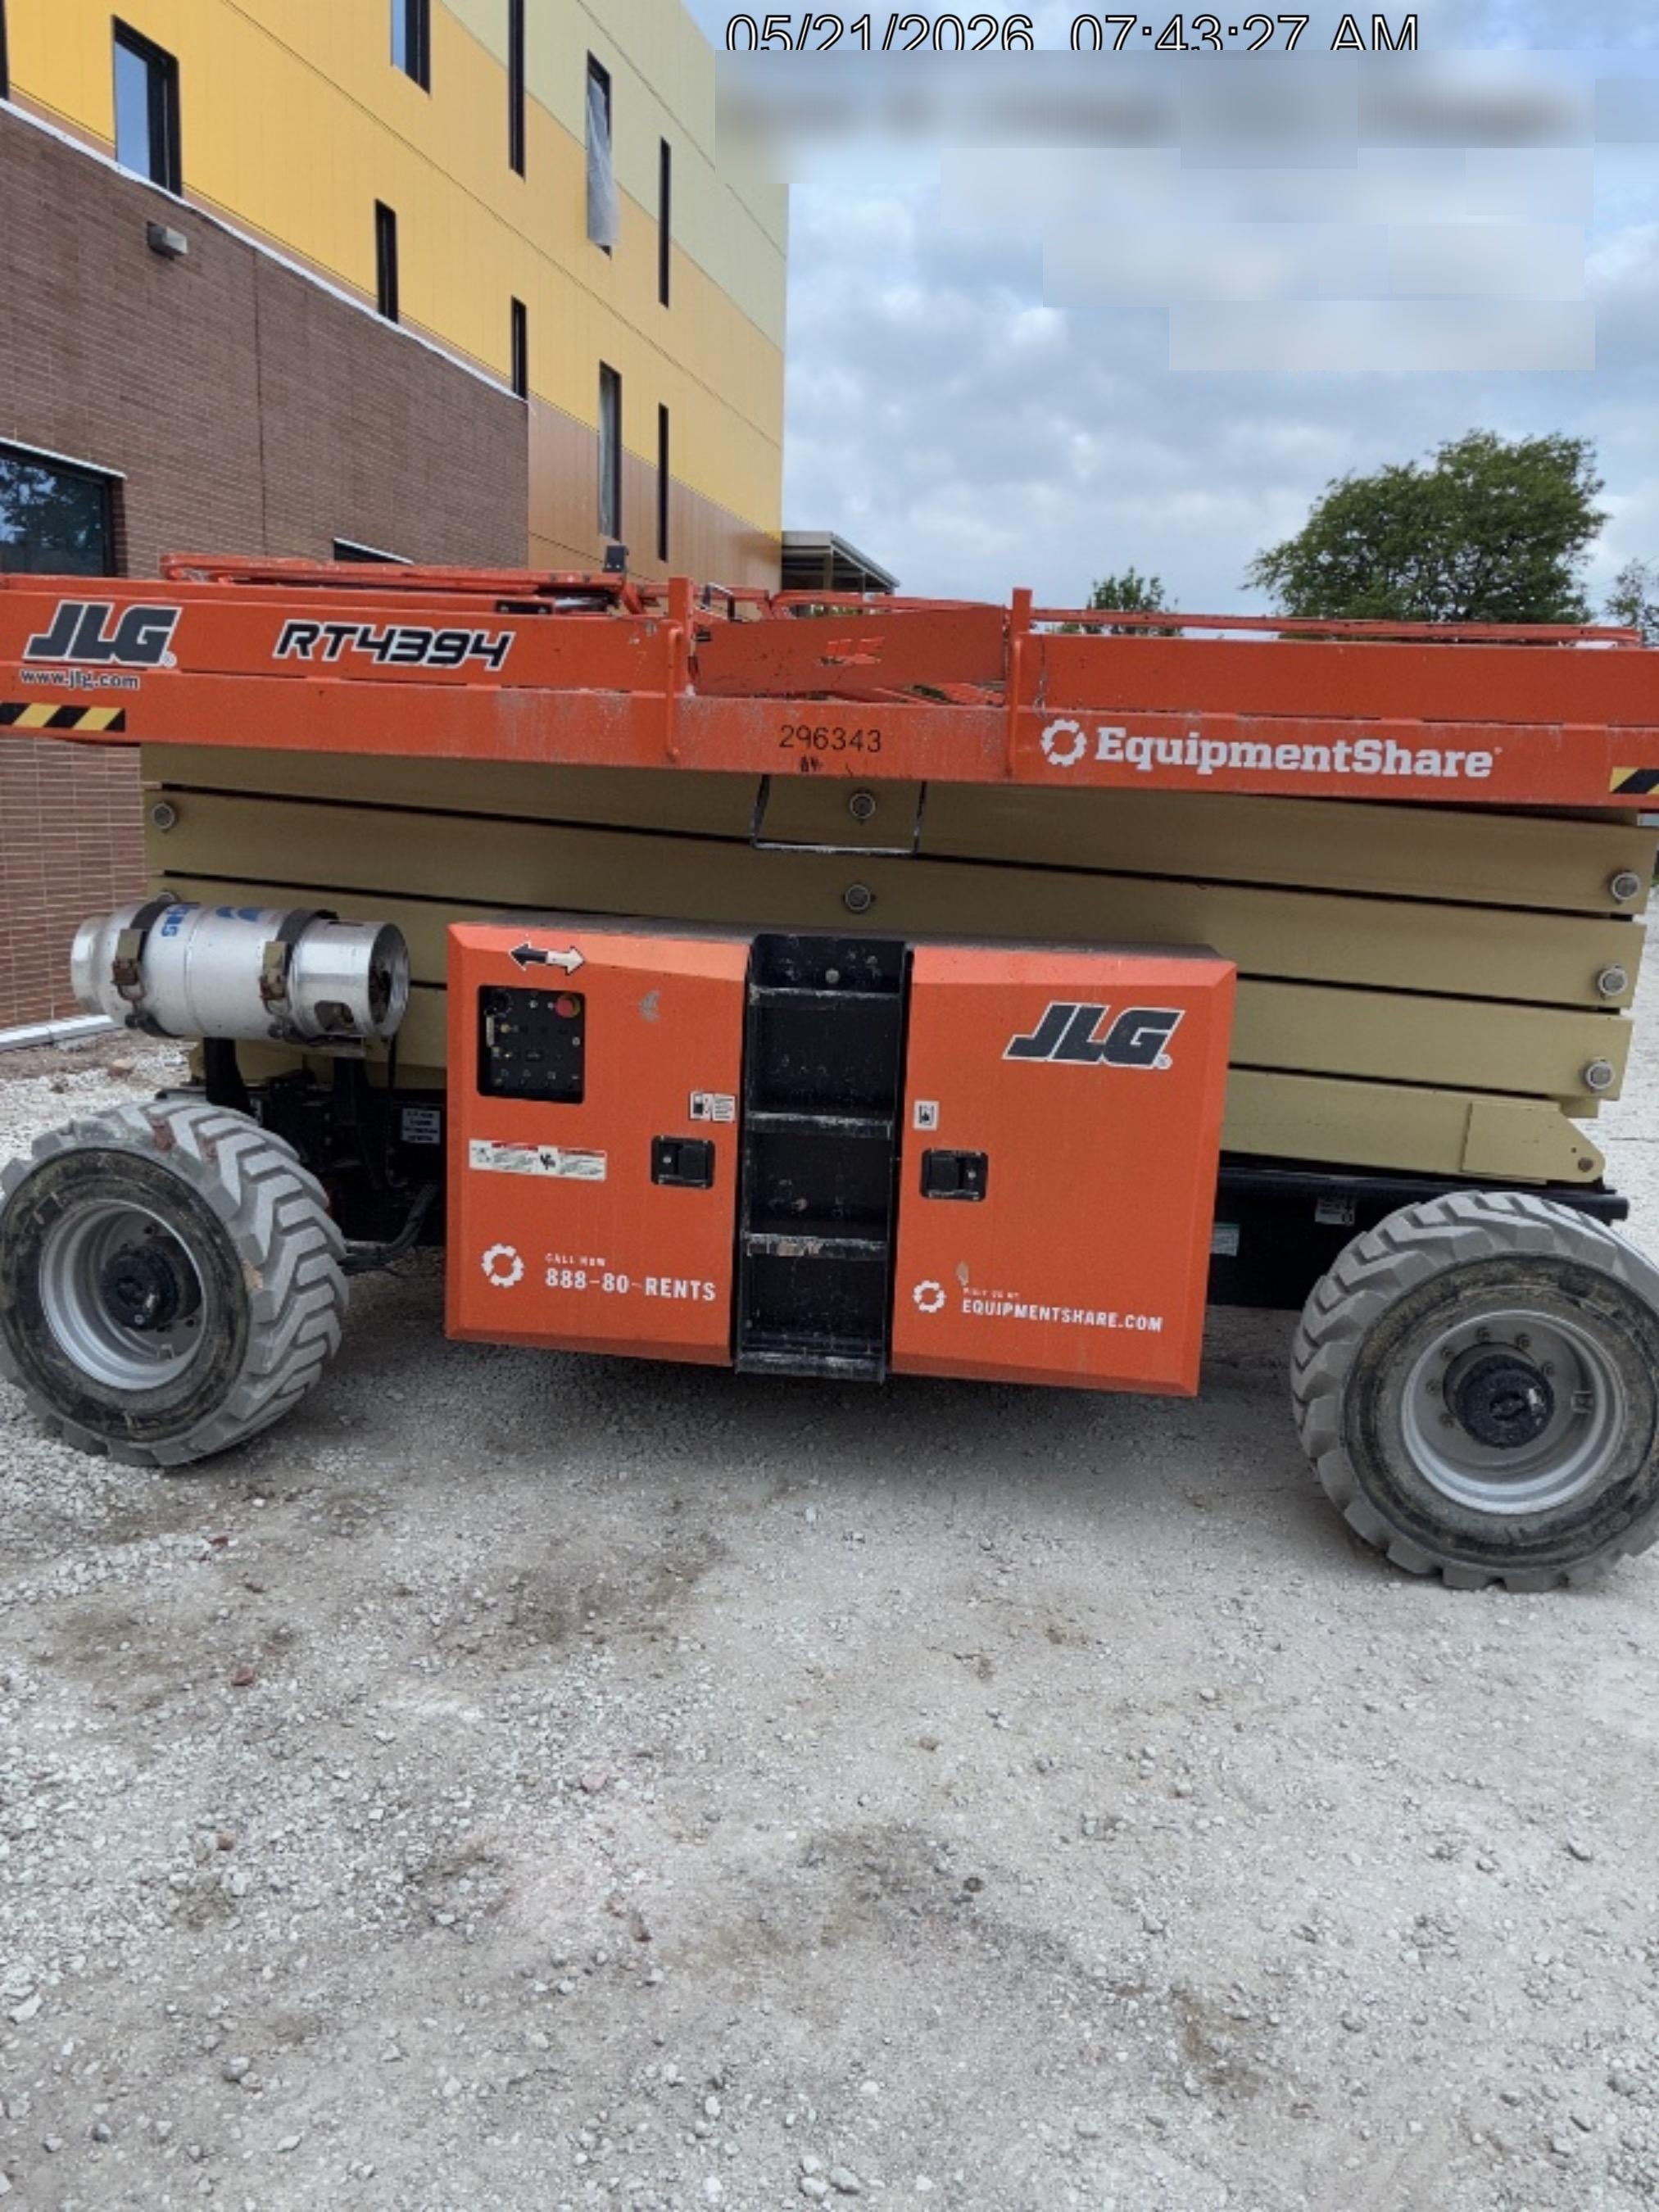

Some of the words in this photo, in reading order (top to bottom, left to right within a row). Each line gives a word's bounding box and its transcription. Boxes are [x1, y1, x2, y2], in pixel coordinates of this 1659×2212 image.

[21, 599, 184, 669] JLG
[272, 619, 516, 672] RT4394
[20, 668, 141, 691] www.jlg.com
[778, 724, 882, 753] 296343
[1095, 725, 1494, 778] EquipmentShare
[1001, 999, 1186, 1070] JLG
[545, 1267, 717, 1302] 888-80-RENTS
[961, 1297, 1163, 1333] EQUIPMENTSHARE.COM
